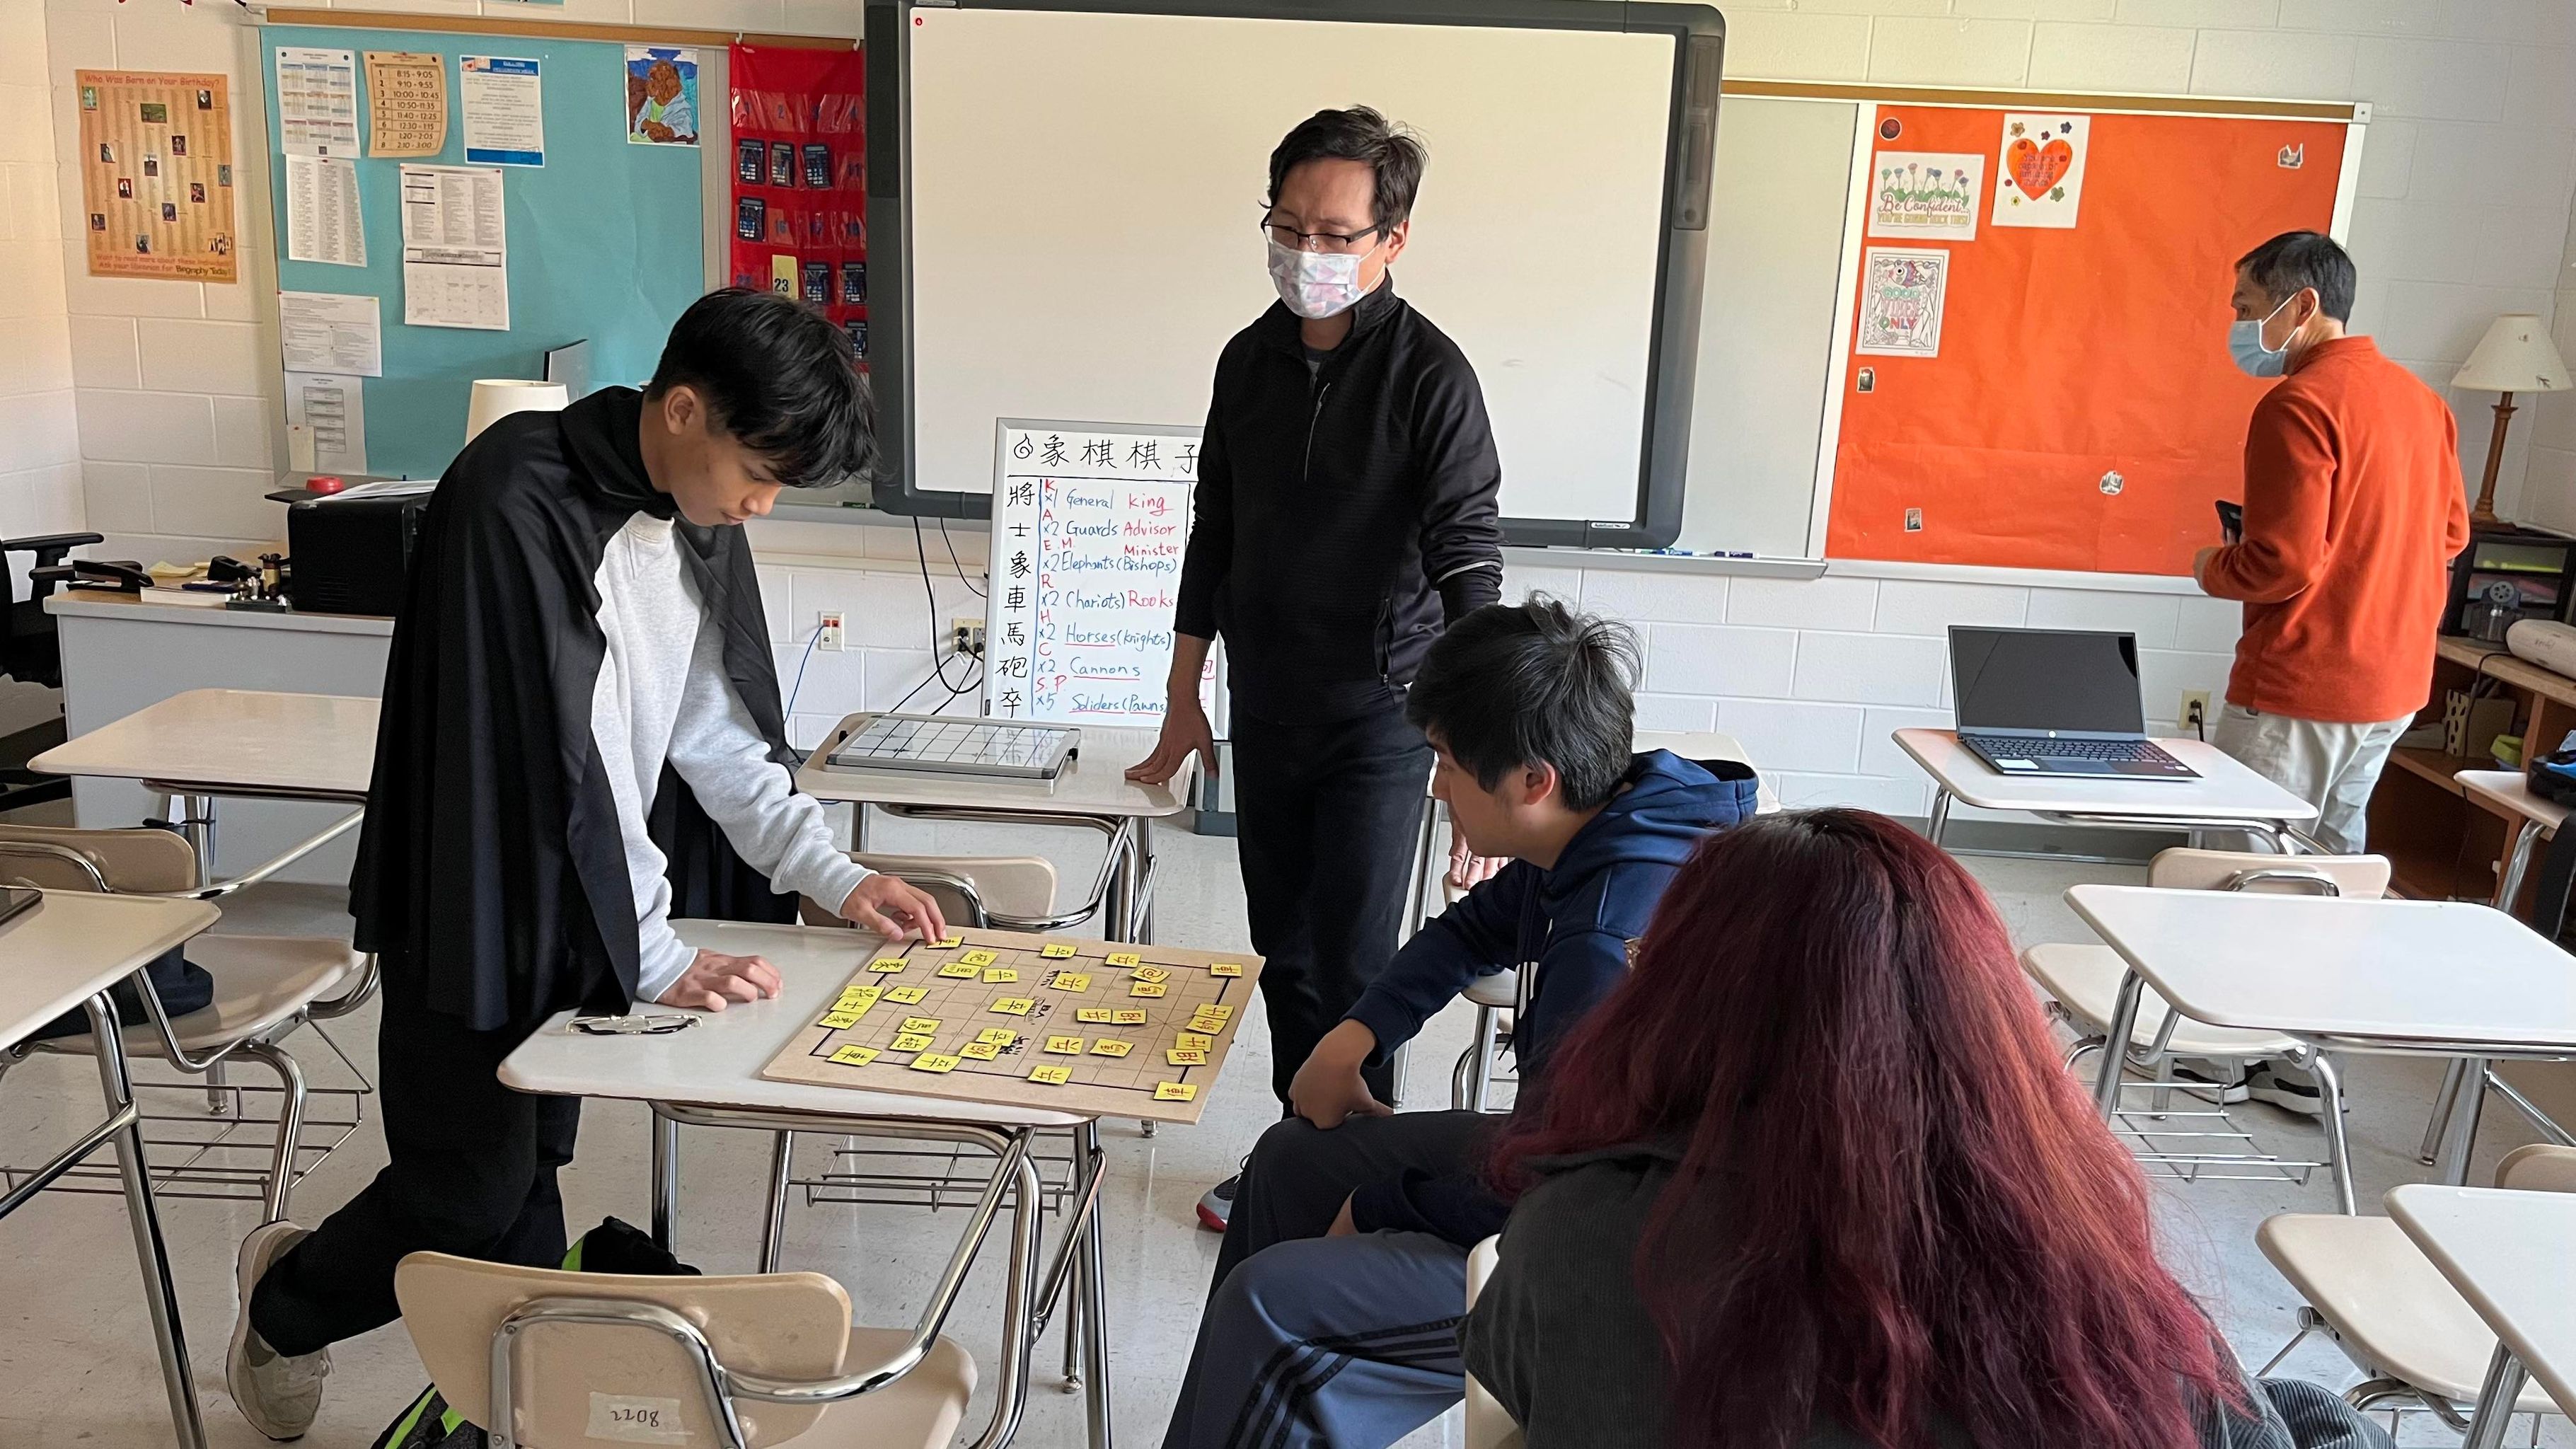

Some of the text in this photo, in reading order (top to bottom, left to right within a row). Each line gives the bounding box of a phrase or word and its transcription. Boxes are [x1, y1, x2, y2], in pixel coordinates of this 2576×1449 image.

[105, 75, 123, 83] Was
[158, 76, 176, 86] Your
[180, 77, 219, 88] Birthday?
[1879, 195, 1901, 212] Be
[175, 265, 208, 277] Biography
[774, 278, 789, 292] 23
[1883, 287, 1919, 299] GOOD
[1879, 316, 1917, 330] ONLY
[1040, 434, 1199, 473] 象棋棋子
[1044, 479, 1056, 492] K
[1007, 481, 1035, 507] 將
[1066, 489, 1114, 509] General
[1042, 509, 1053, 521] A
[1008, 522, 1031, 537] 士
[1067, 519, 1119, 537] Guards
[1124, 519, 1176, 536] Advisor
[1124, 543, 1179, 556] Minister
[1010, 550, 1031, 578] 象
[1041, 574, 1053, 589] R
[1004, 585, 1026, 613] 車
[1128, 589, 1174, 608] Rooks
[1041, 609, 1051, 623] H
[1000, 622, 1024, 646] 馬
[1039, 642, 1052, 656] C
[995, 657, 1027, 678] 砲
[1070, 657, 1140, 676] Cannons
[1000, 688, 1022, 718] 卒
[1114, 956, 1135, 964] 兵
[1057, 977, 1082, 989] 兵
[1085, 1011, 1108, 1020] 兵
[1052, 1039, 1078, 1051] 兵
[841, 1050, 867, 1059] 車
[923, 1057, 952, 1068] 卒
[1036, 1070, 1063, 1080] 兵
